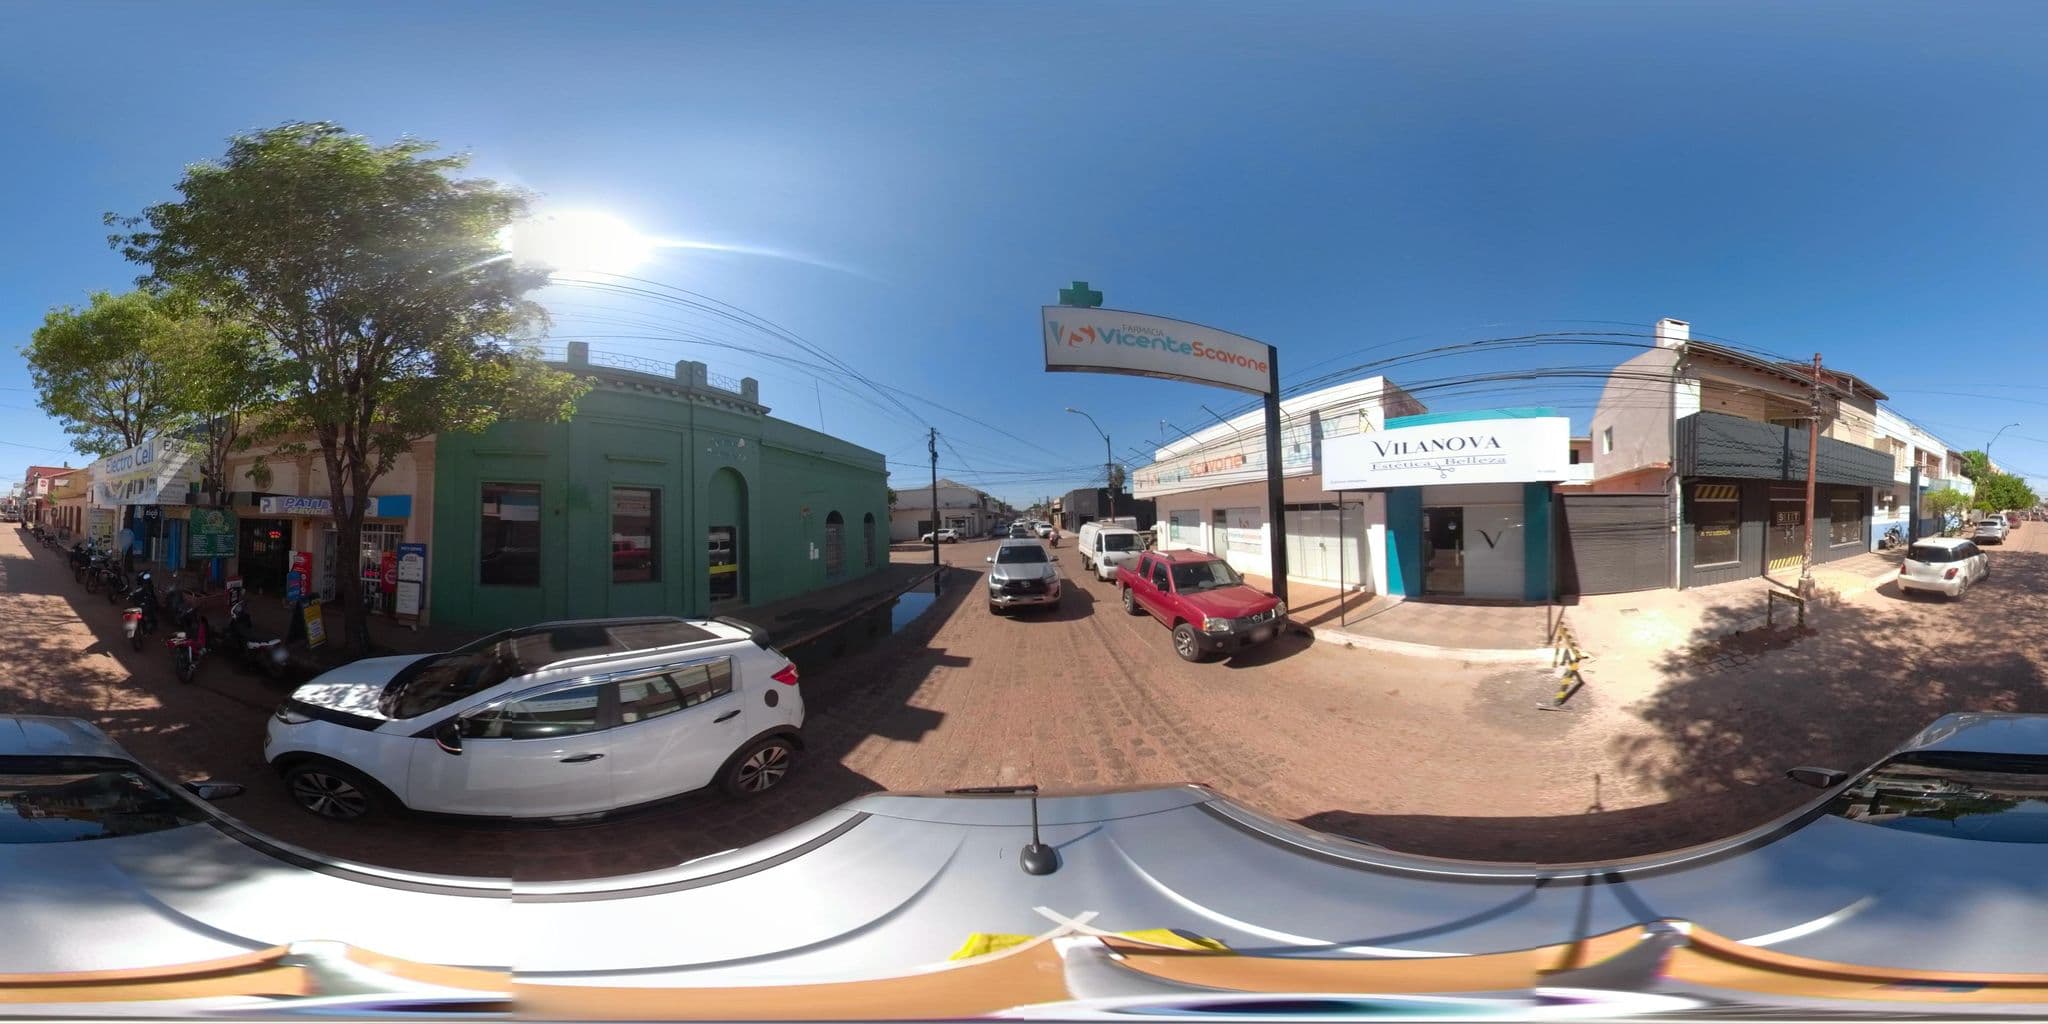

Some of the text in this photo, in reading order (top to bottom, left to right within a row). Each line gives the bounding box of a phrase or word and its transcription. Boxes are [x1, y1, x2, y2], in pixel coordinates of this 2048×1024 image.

[1121, 324, 1164, 336] FARMACIA
[1370, 435, 1502, 457] VILANOVA
[106, 442, 154, 474] Electro Cell
[1473, 528, 1503, 548] V
